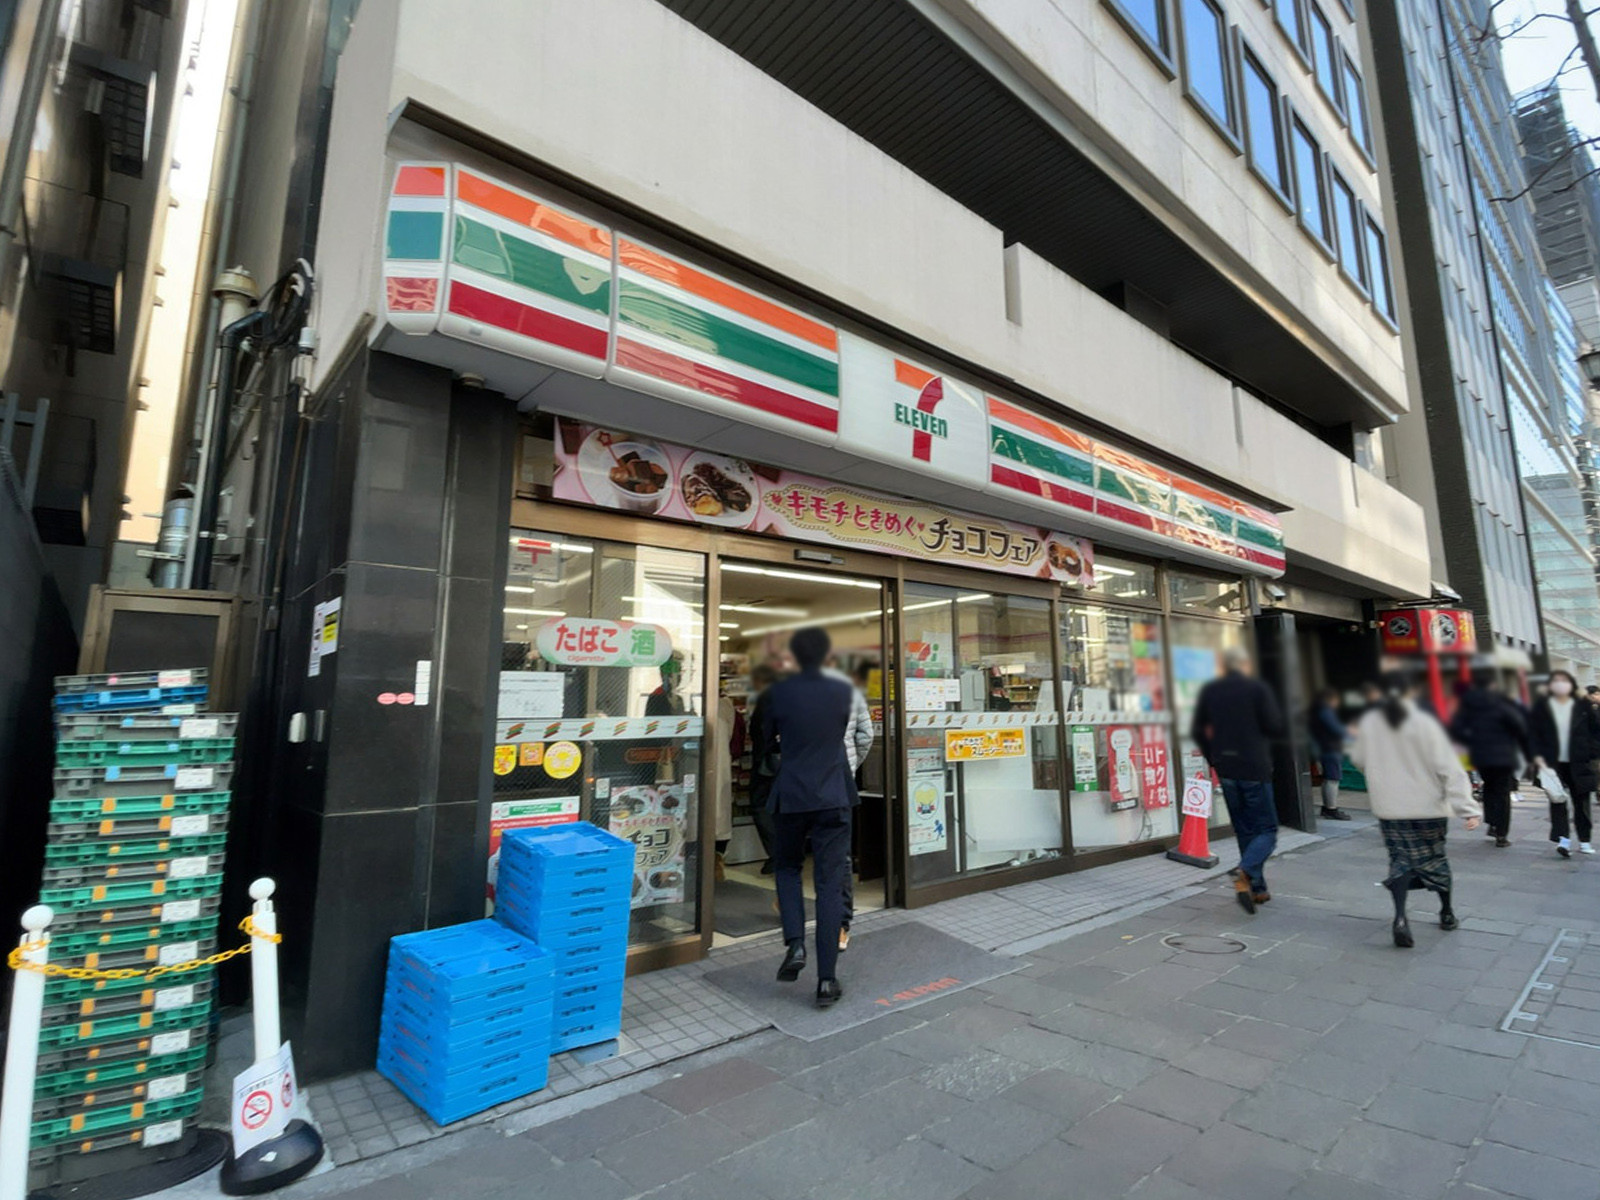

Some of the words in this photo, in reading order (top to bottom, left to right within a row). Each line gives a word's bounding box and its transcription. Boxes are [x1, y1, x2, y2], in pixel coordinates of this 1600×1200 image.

[786, 490, 917, 538] キモチときめく
[919, 518, 1040, 562] チョコフェア
[555, 623, 618, 653] たばこ
[631, 629, 656, 656] 酒
